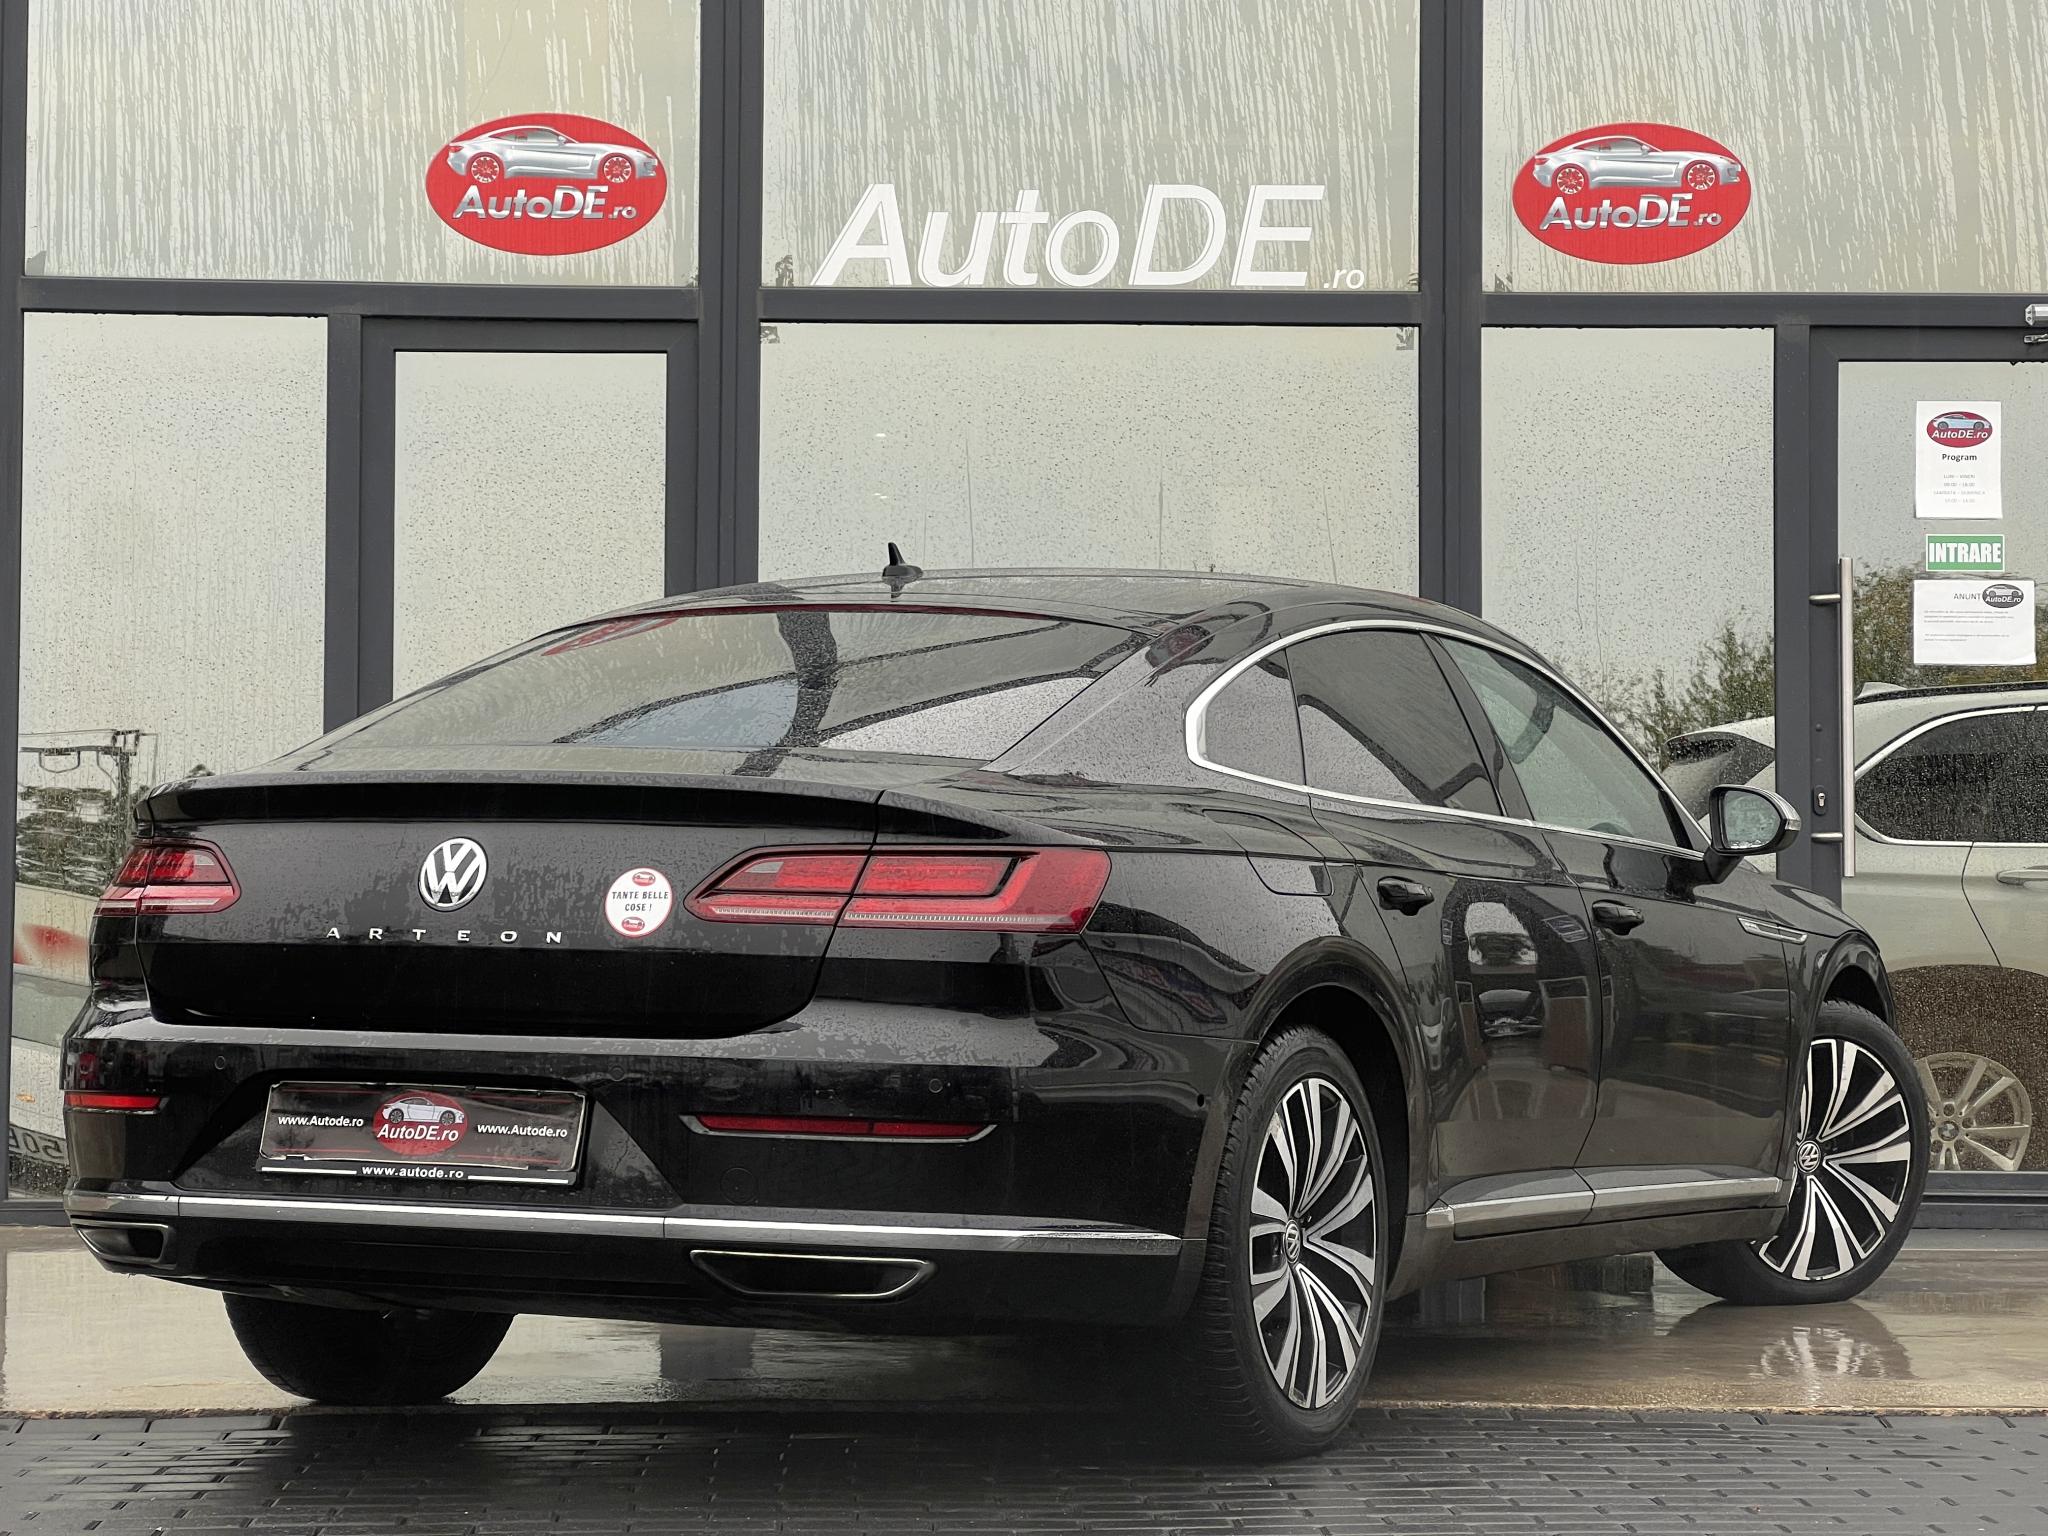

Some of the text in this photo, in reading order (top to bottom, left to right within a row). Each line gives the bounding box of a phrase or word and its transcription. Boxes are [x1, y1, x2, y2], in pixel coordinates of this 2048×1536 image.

[1931, 429, 1989, 440] AutoDE.ro
[1941, 453, 1978, 463] Program
[1928, 542, 2002, 563] INTRARE
[612, 891, 669, 900] TANTE BELLE
[326, 927, 562, 944] ARTEON
[277, 1114, 364, 1128] www.Autode.ro
[376, 1122, 460, 1142] AutoDE.ro
[477, 1123, 568, 1139] www.Autode.ro
[361, 1164, 464, 1180] www.autode.ro
